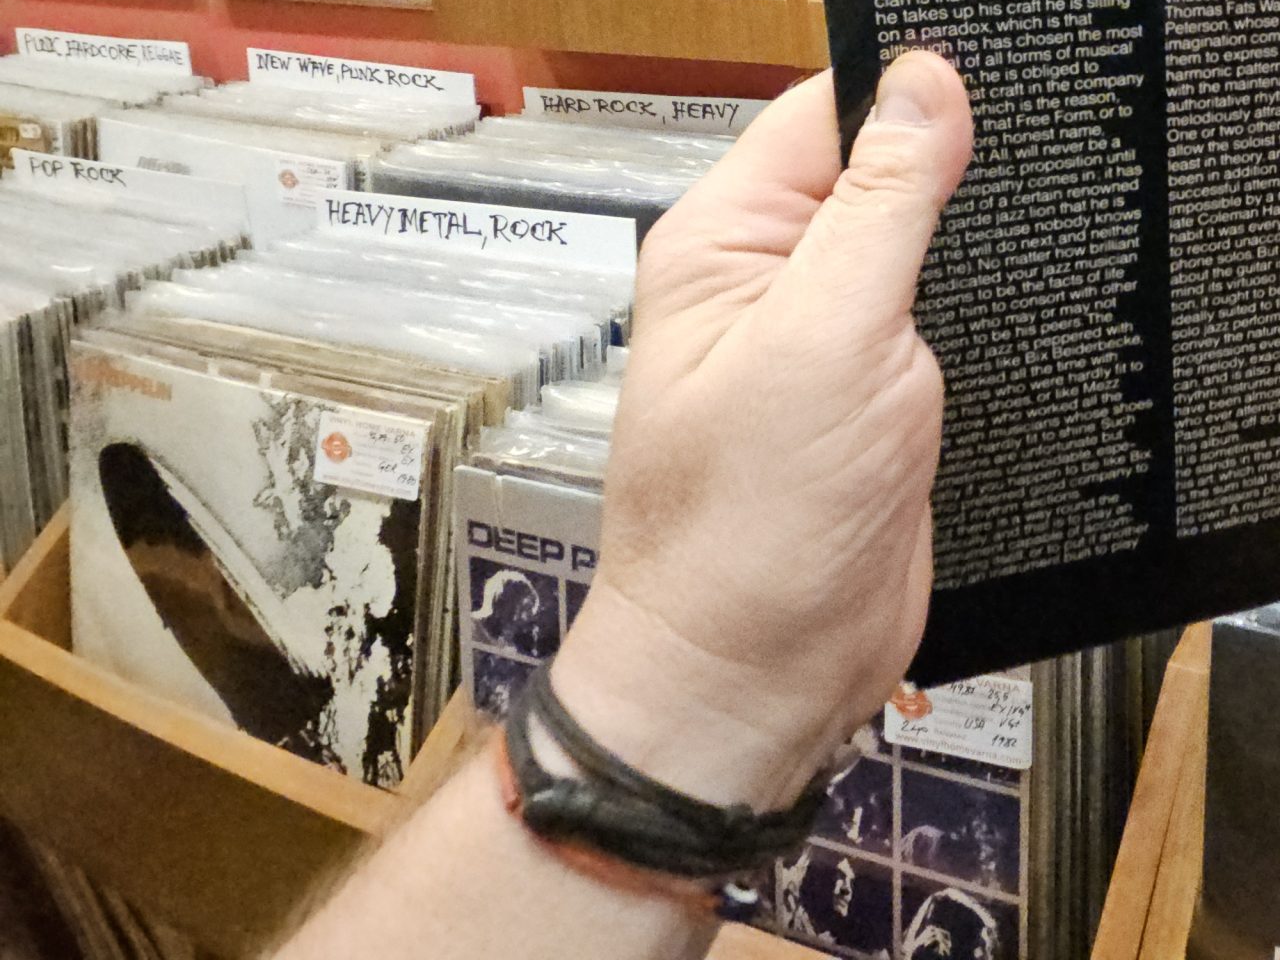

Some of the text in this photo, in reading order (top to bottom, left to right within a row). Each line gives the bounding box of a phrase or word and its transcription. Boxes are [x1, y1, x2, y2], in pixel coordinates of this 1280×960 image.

[256, 52, 292, 72] NEW
[340, 63, 384, 85] PUNK
[385, 68, 444, 91] ROCK
[540, 95, 594, 113] HARD
[672, 101, 740, 126] HEAVY
[30, 156, 128, 187] POP ROCK
[325, 199, 395, 227] HEAVY
[490, 214, 568, 245] ROCK
[467, 519, 565, 564] DEEP
